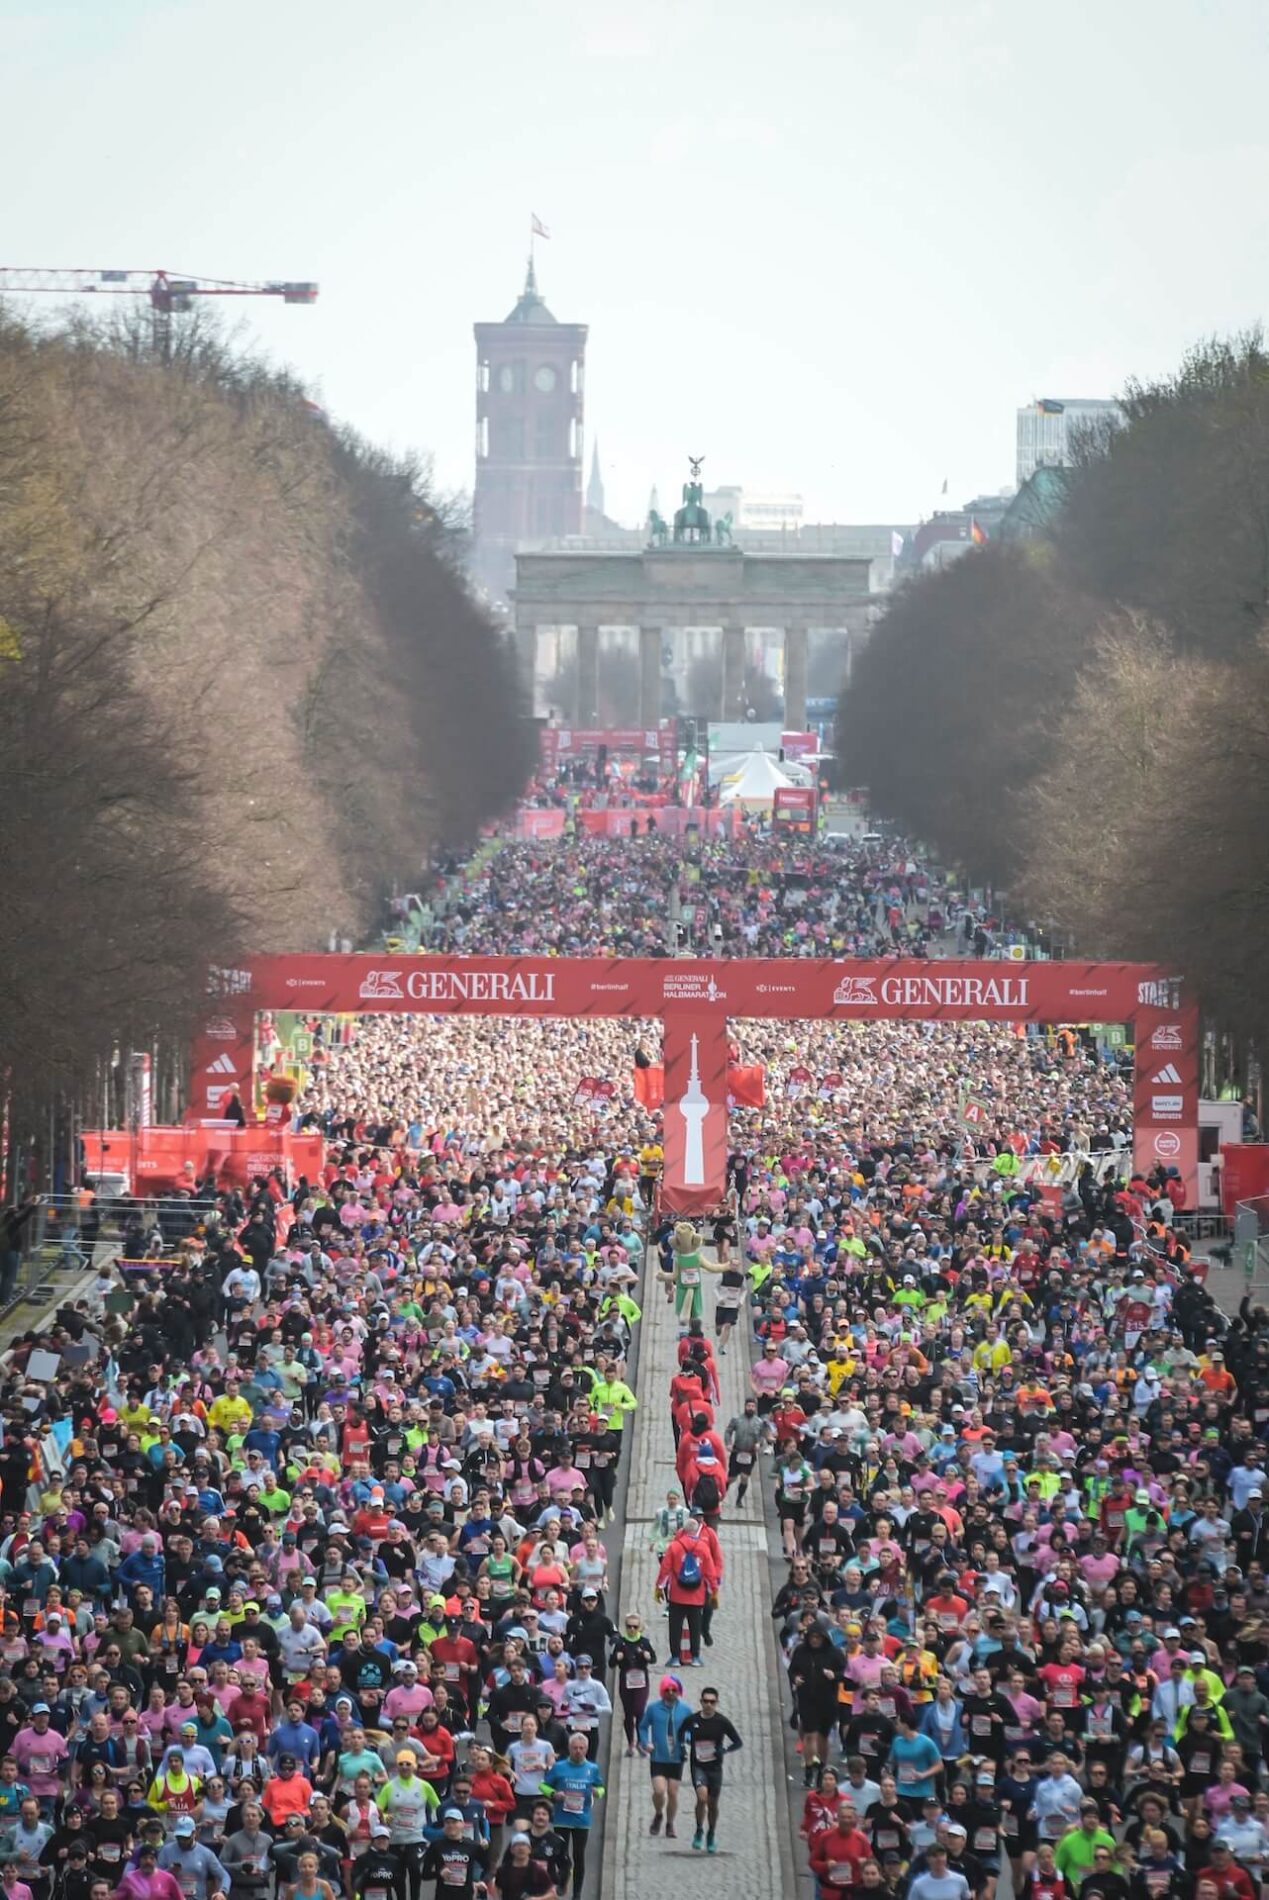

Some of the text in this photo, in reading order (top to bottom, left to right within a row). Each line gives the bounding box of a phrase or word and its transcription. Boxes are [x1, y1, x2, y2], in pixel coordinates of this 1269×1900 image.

[406, 971, 556, 1001] GENERALI
[674, 974, 709, 983] GENERALI
[663, 983, 702, 991] BERLINER
[881, 977, 1029, 1006] GENERALI
[298, 1037, 308, 1052] B
[1111, 1030, 1121, 1045] B
[965, 1105, 979, 1122] A
[441, 1854, 470, 1863] YoPRO
